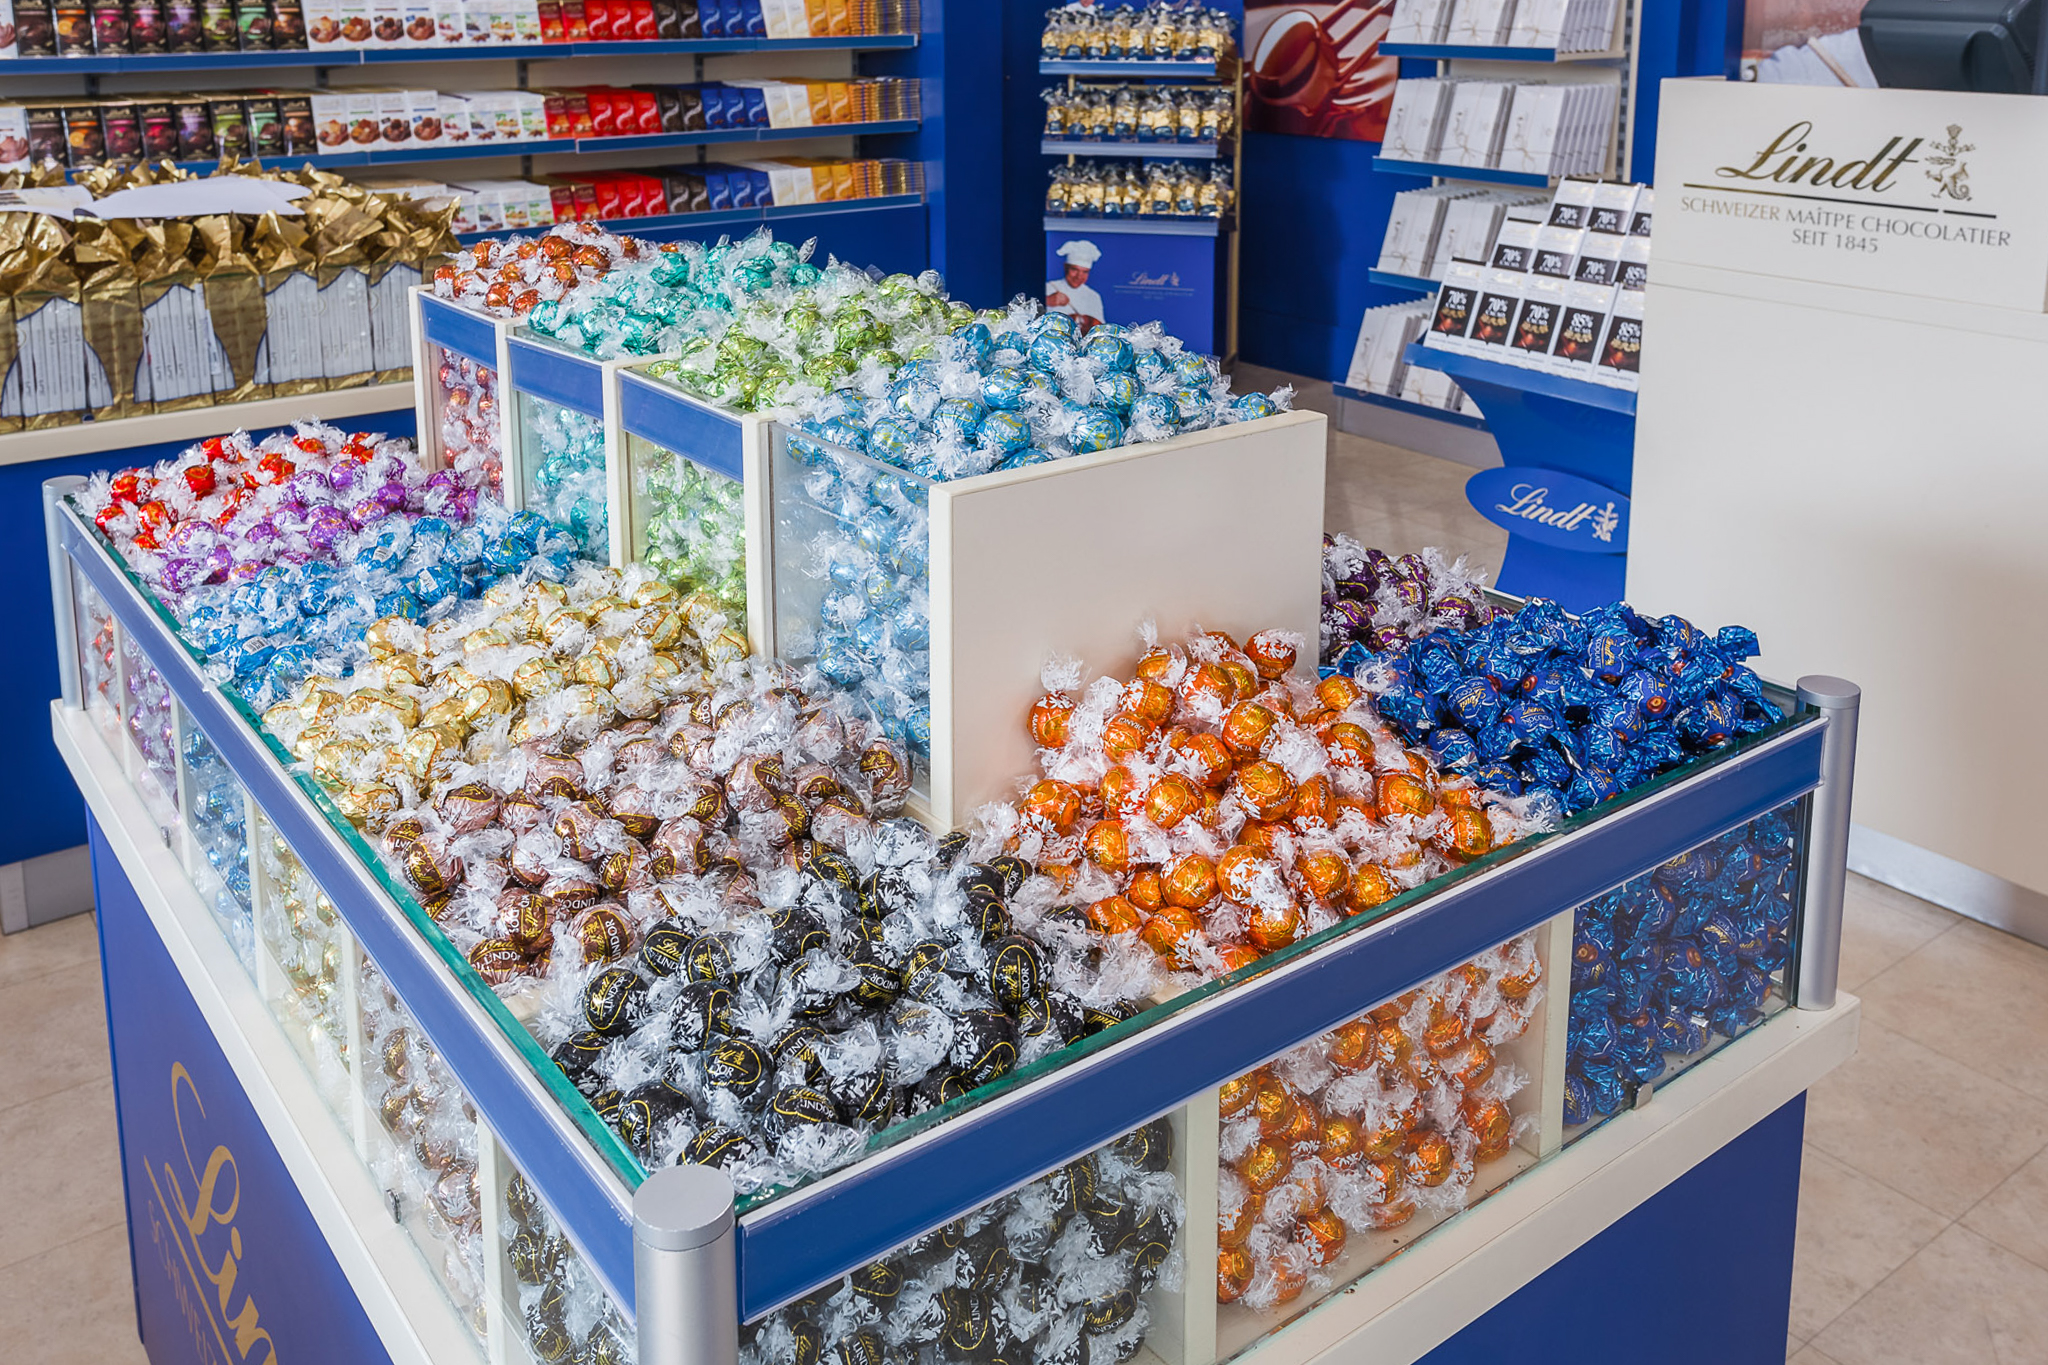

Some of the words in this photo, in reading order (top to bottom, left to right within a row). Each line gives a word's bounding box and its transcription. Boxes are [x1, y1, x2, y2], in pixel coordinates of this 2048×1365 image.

[1715, 121, 1924, 192] Lindt
[1681, 197, 1780, 221] SCHWEIZER
[1861, 216, 2011, 247] CHOCOLATIER
[1792, 228, 1826, 246] SEIT
[1835, 233, 1878, 254] 1845
[1495, 483, 1597, 531] Lindt
[1156, 804, 1176, 826] NDOR
[605, 918, 622, 961] LINDOR
[656, 955, 680, 972] LIND
[908, 966, 931, 988] NDOR
[1020, 967, 1030, 998] NDOR
[591, 975, 612, 1014] Lindt
[605, 974, 626, 1013] LINDOR
[165, 1062, 278, 1365] Lin
